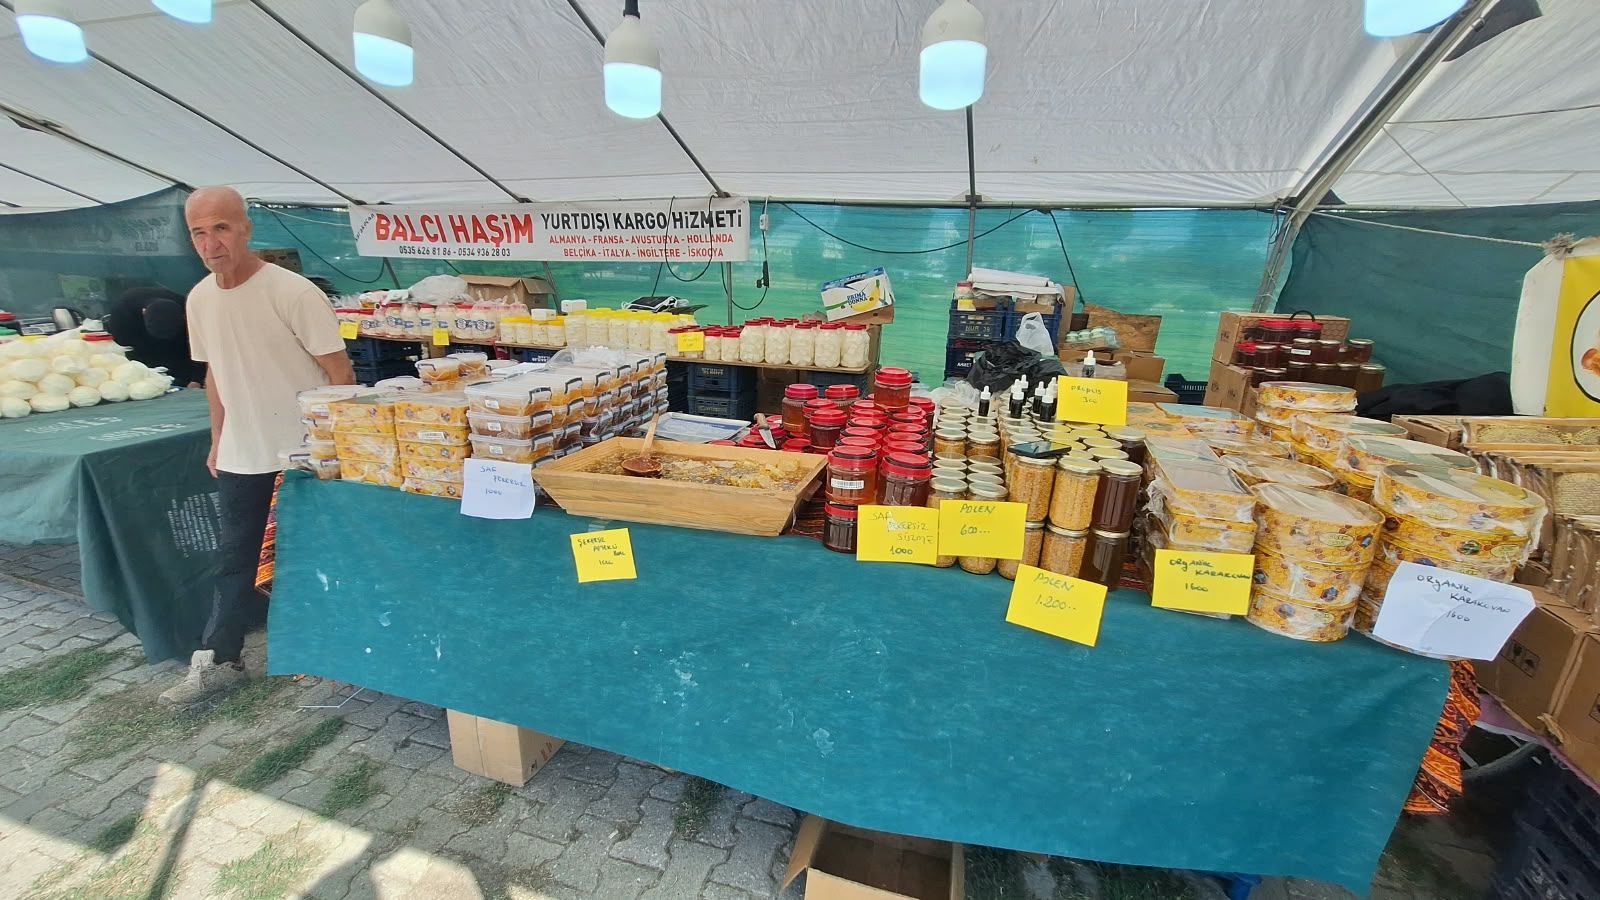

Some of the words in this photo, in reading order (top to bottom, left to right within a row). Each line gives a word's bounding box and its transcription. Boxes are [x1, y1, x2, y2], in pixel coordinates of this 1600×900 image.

[541, 212, 609, 231] YURTDIŞI
[612, 211, 668, 230] KARGO
[375, 213, 447, 243] BALCI
[549, 234, 587, 244] ALMANYA
[593, 234, 625, 244] FRANSA
[630, 234, 680, 244] AVUSTURYA
[687, 233, 734, 243] HOLLANDA
[399, 245, 416, 255] 0535
[417, 246, 430, 255] 626
[432, 247, 440, 255] 81
[458, 247, 475, 256] 0534
[476, 247, 490, 257] 936
[491, 248, 500, 257] 28
[502, 248, 511, 257] 03
[564, 246, 597, 258] BELÇİKA
[602, 246, 631, 257] İTALYA
[637, 246, 680, 258] İNGİLTERE
[960, 503, 996, 514] POLEN
[889, 545, 914, 555] 1000
[1033, 572, 1074, 592] POLEN
[1446, 610, 1471, 622] 1600
